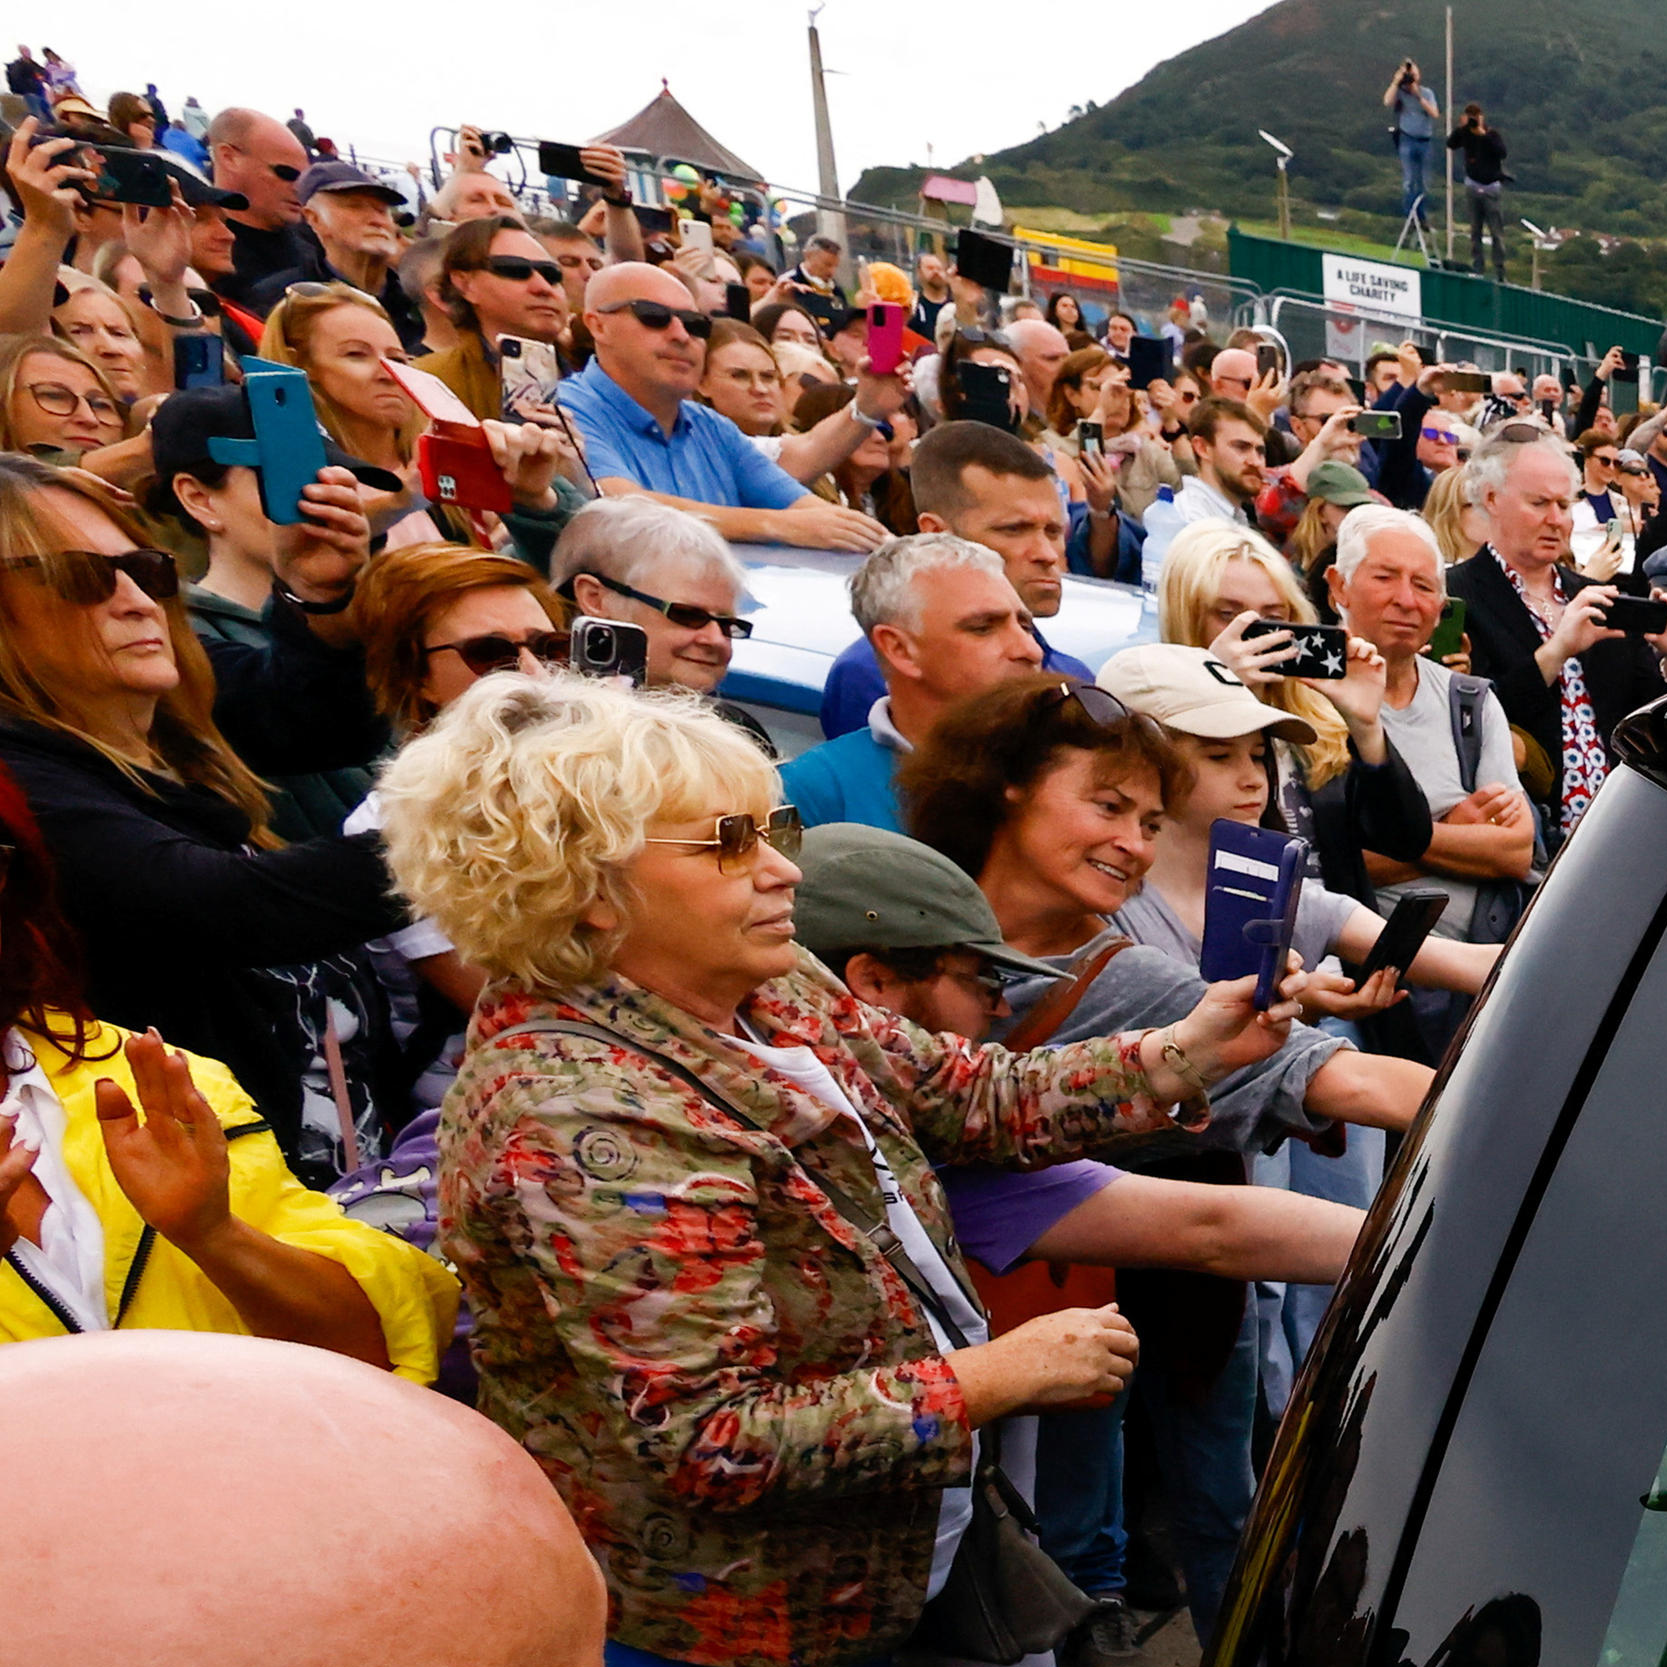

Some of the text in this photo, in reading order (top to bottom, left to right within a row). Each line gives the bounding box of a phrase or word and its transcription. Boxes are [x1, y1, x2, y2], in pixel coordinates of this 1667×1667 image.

[1337, 269, 1408, 292] A LIFE SAVING
[1350, 284, 1396, 302] CHARITY
